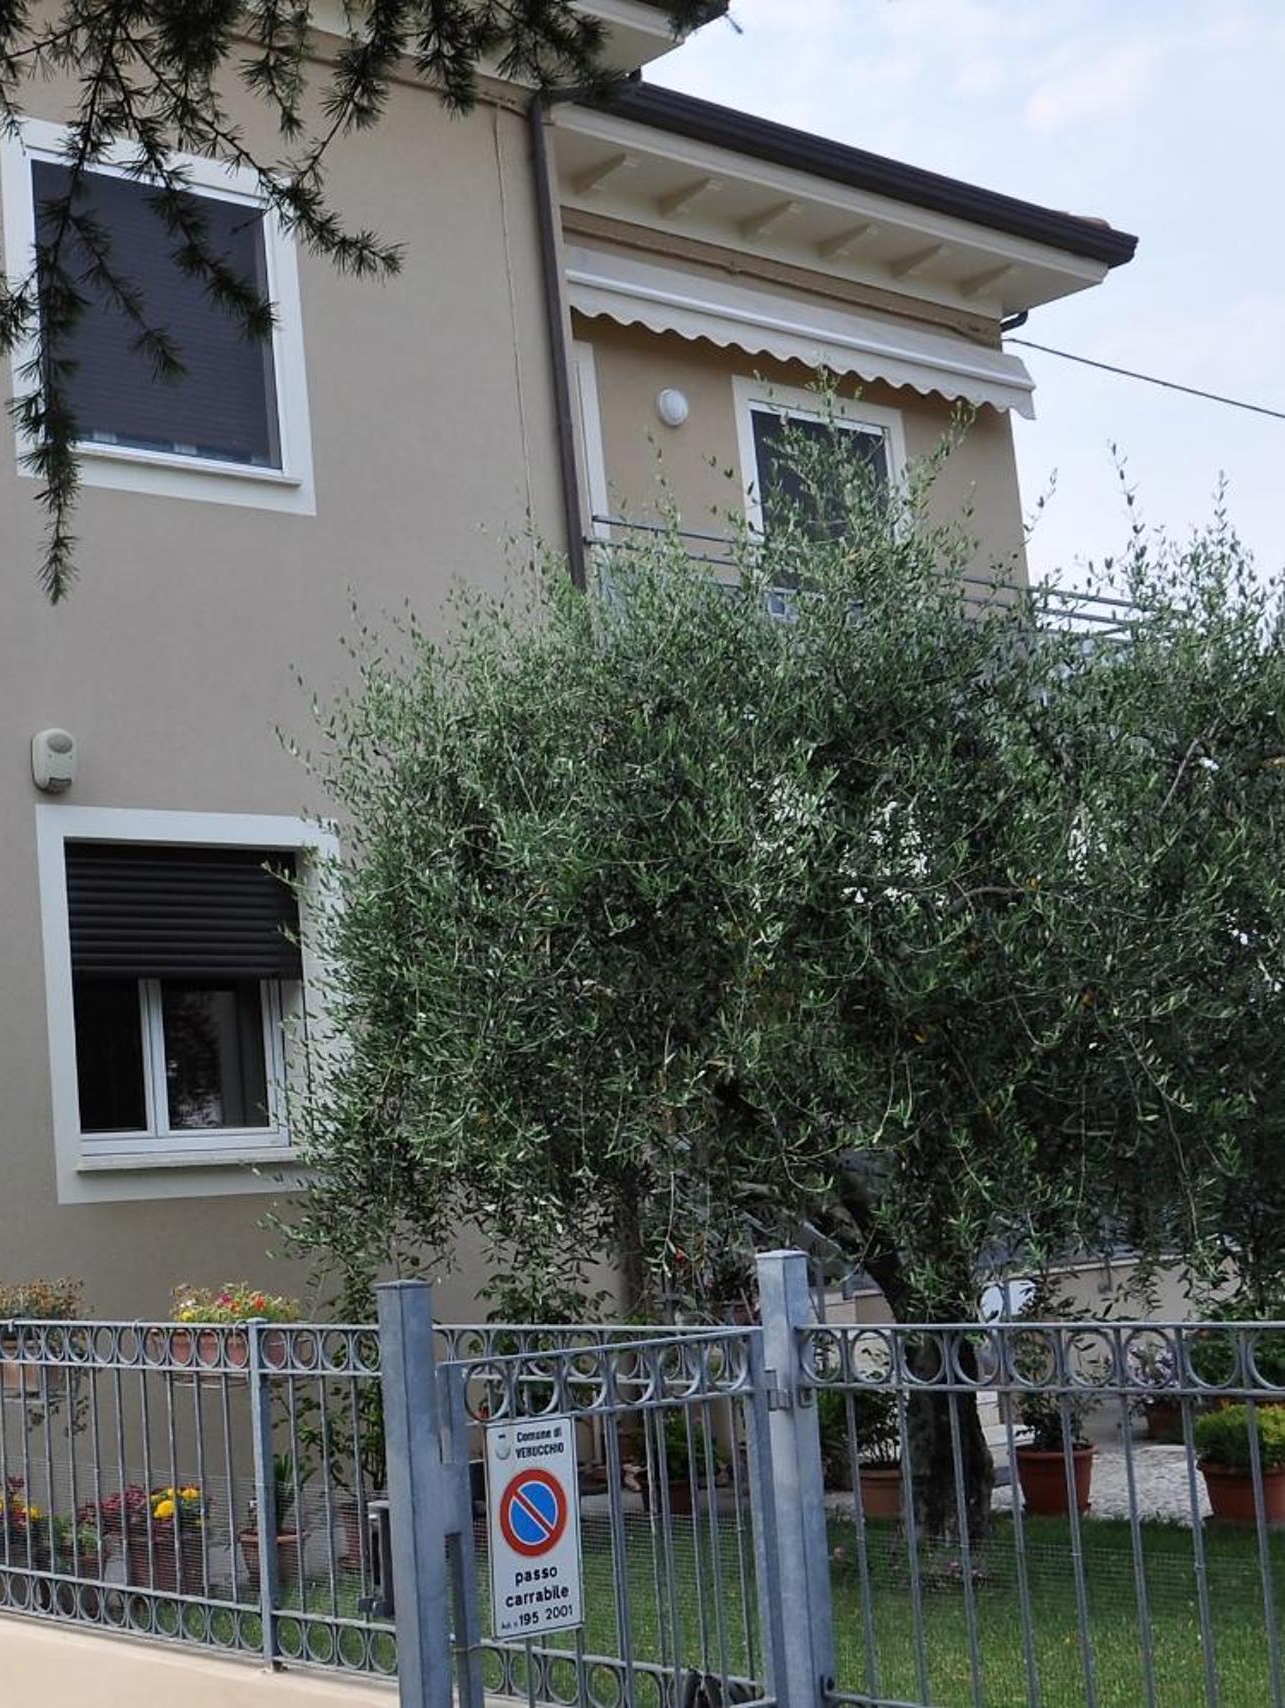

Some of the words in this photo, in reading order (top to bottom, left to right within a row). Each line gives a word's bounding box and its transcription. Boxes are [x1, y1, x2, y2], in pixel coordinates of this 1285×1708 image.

[517, 1429, 552, 1443] Comune
[553, 1427, 562, 1438] di
[515, 1566, 558, 1587] passo
[506, 1585, 569, 1607] carrabile
[519, 1611, 539, 1626] 195
[545, 1604, 573, 1620] 2001
